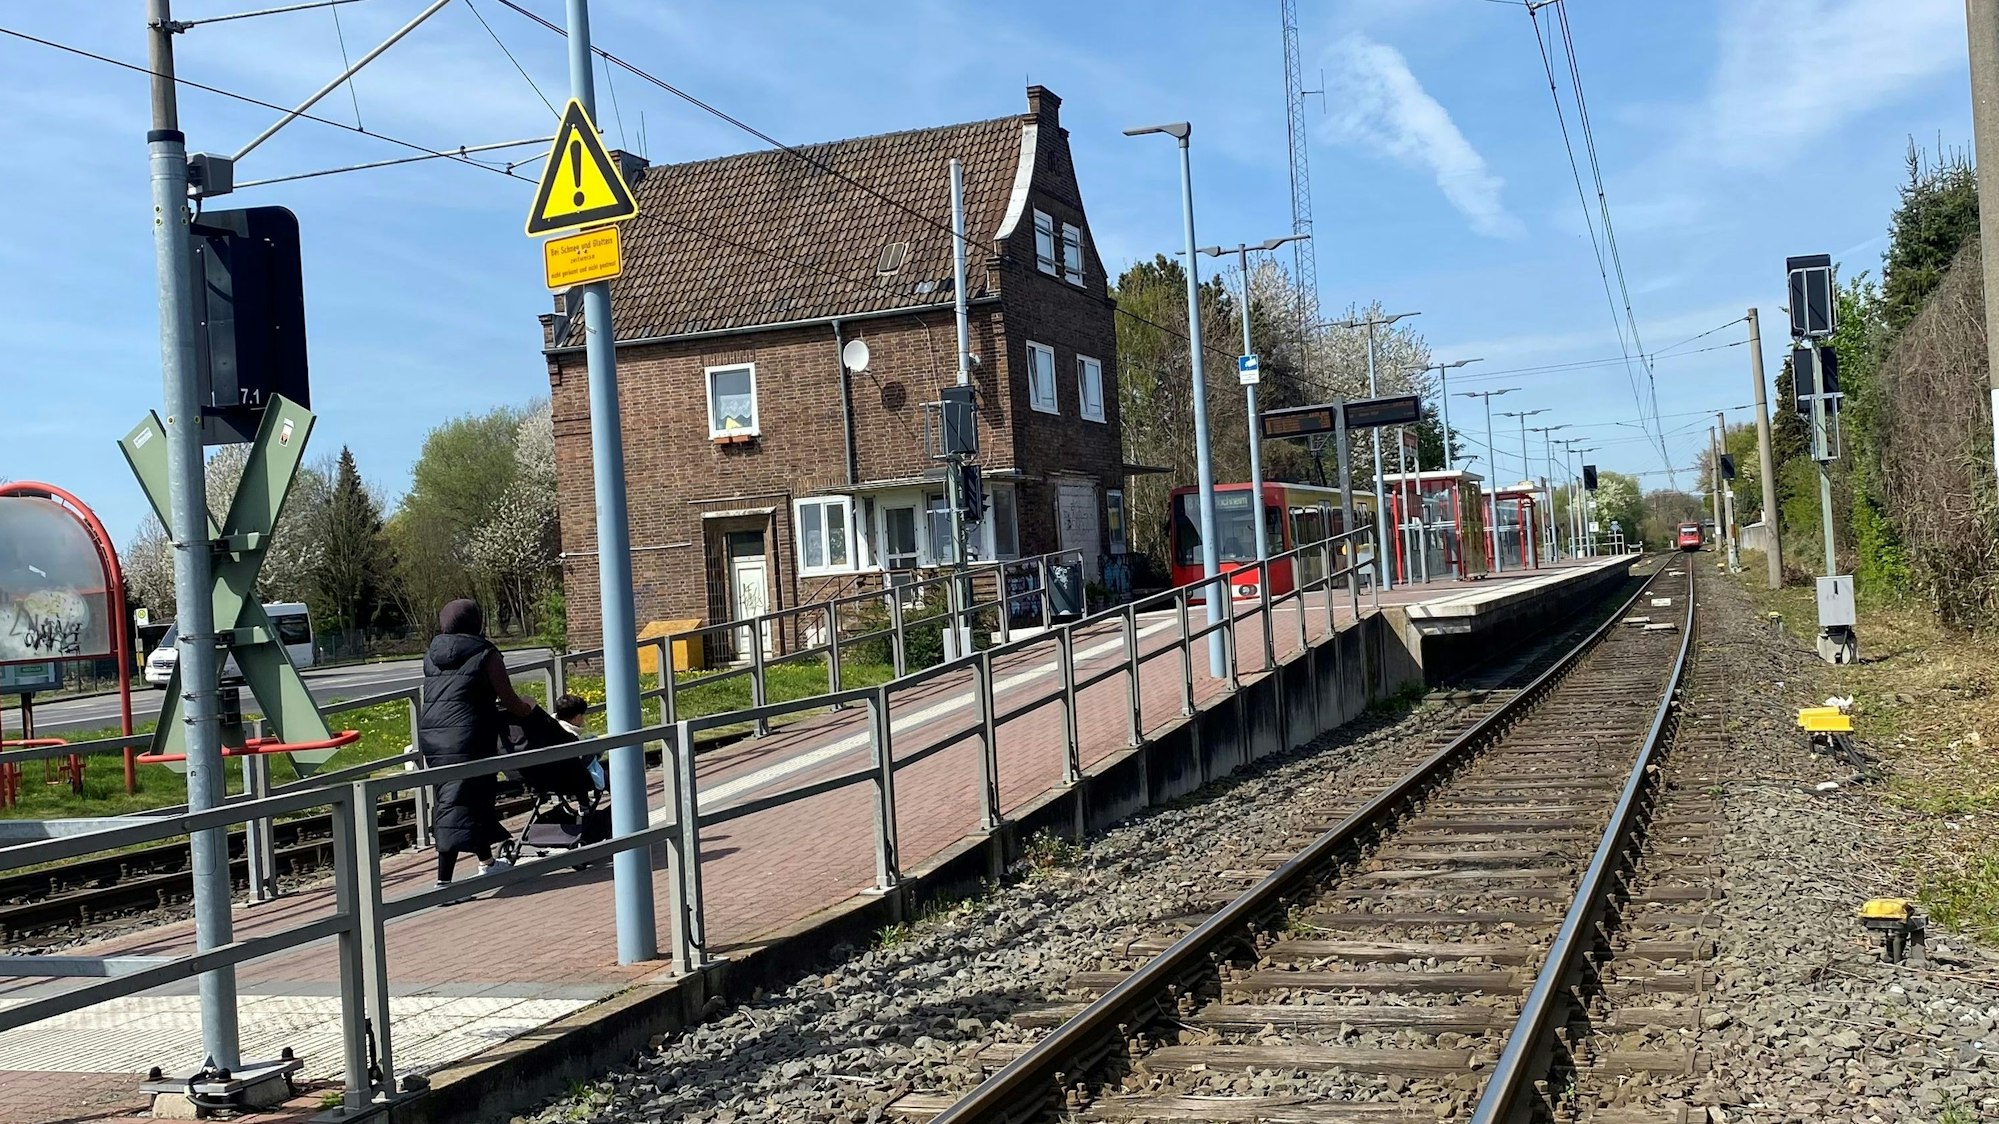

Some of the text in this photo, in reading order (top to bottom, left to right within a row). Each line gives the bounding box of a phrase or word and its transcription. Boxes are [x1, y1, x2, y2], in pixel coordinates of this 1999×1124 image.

[561, 245, 579, 254] Schnee
[581, 242, 590, 250] und
[240, 388, 260, 404] 7.1
